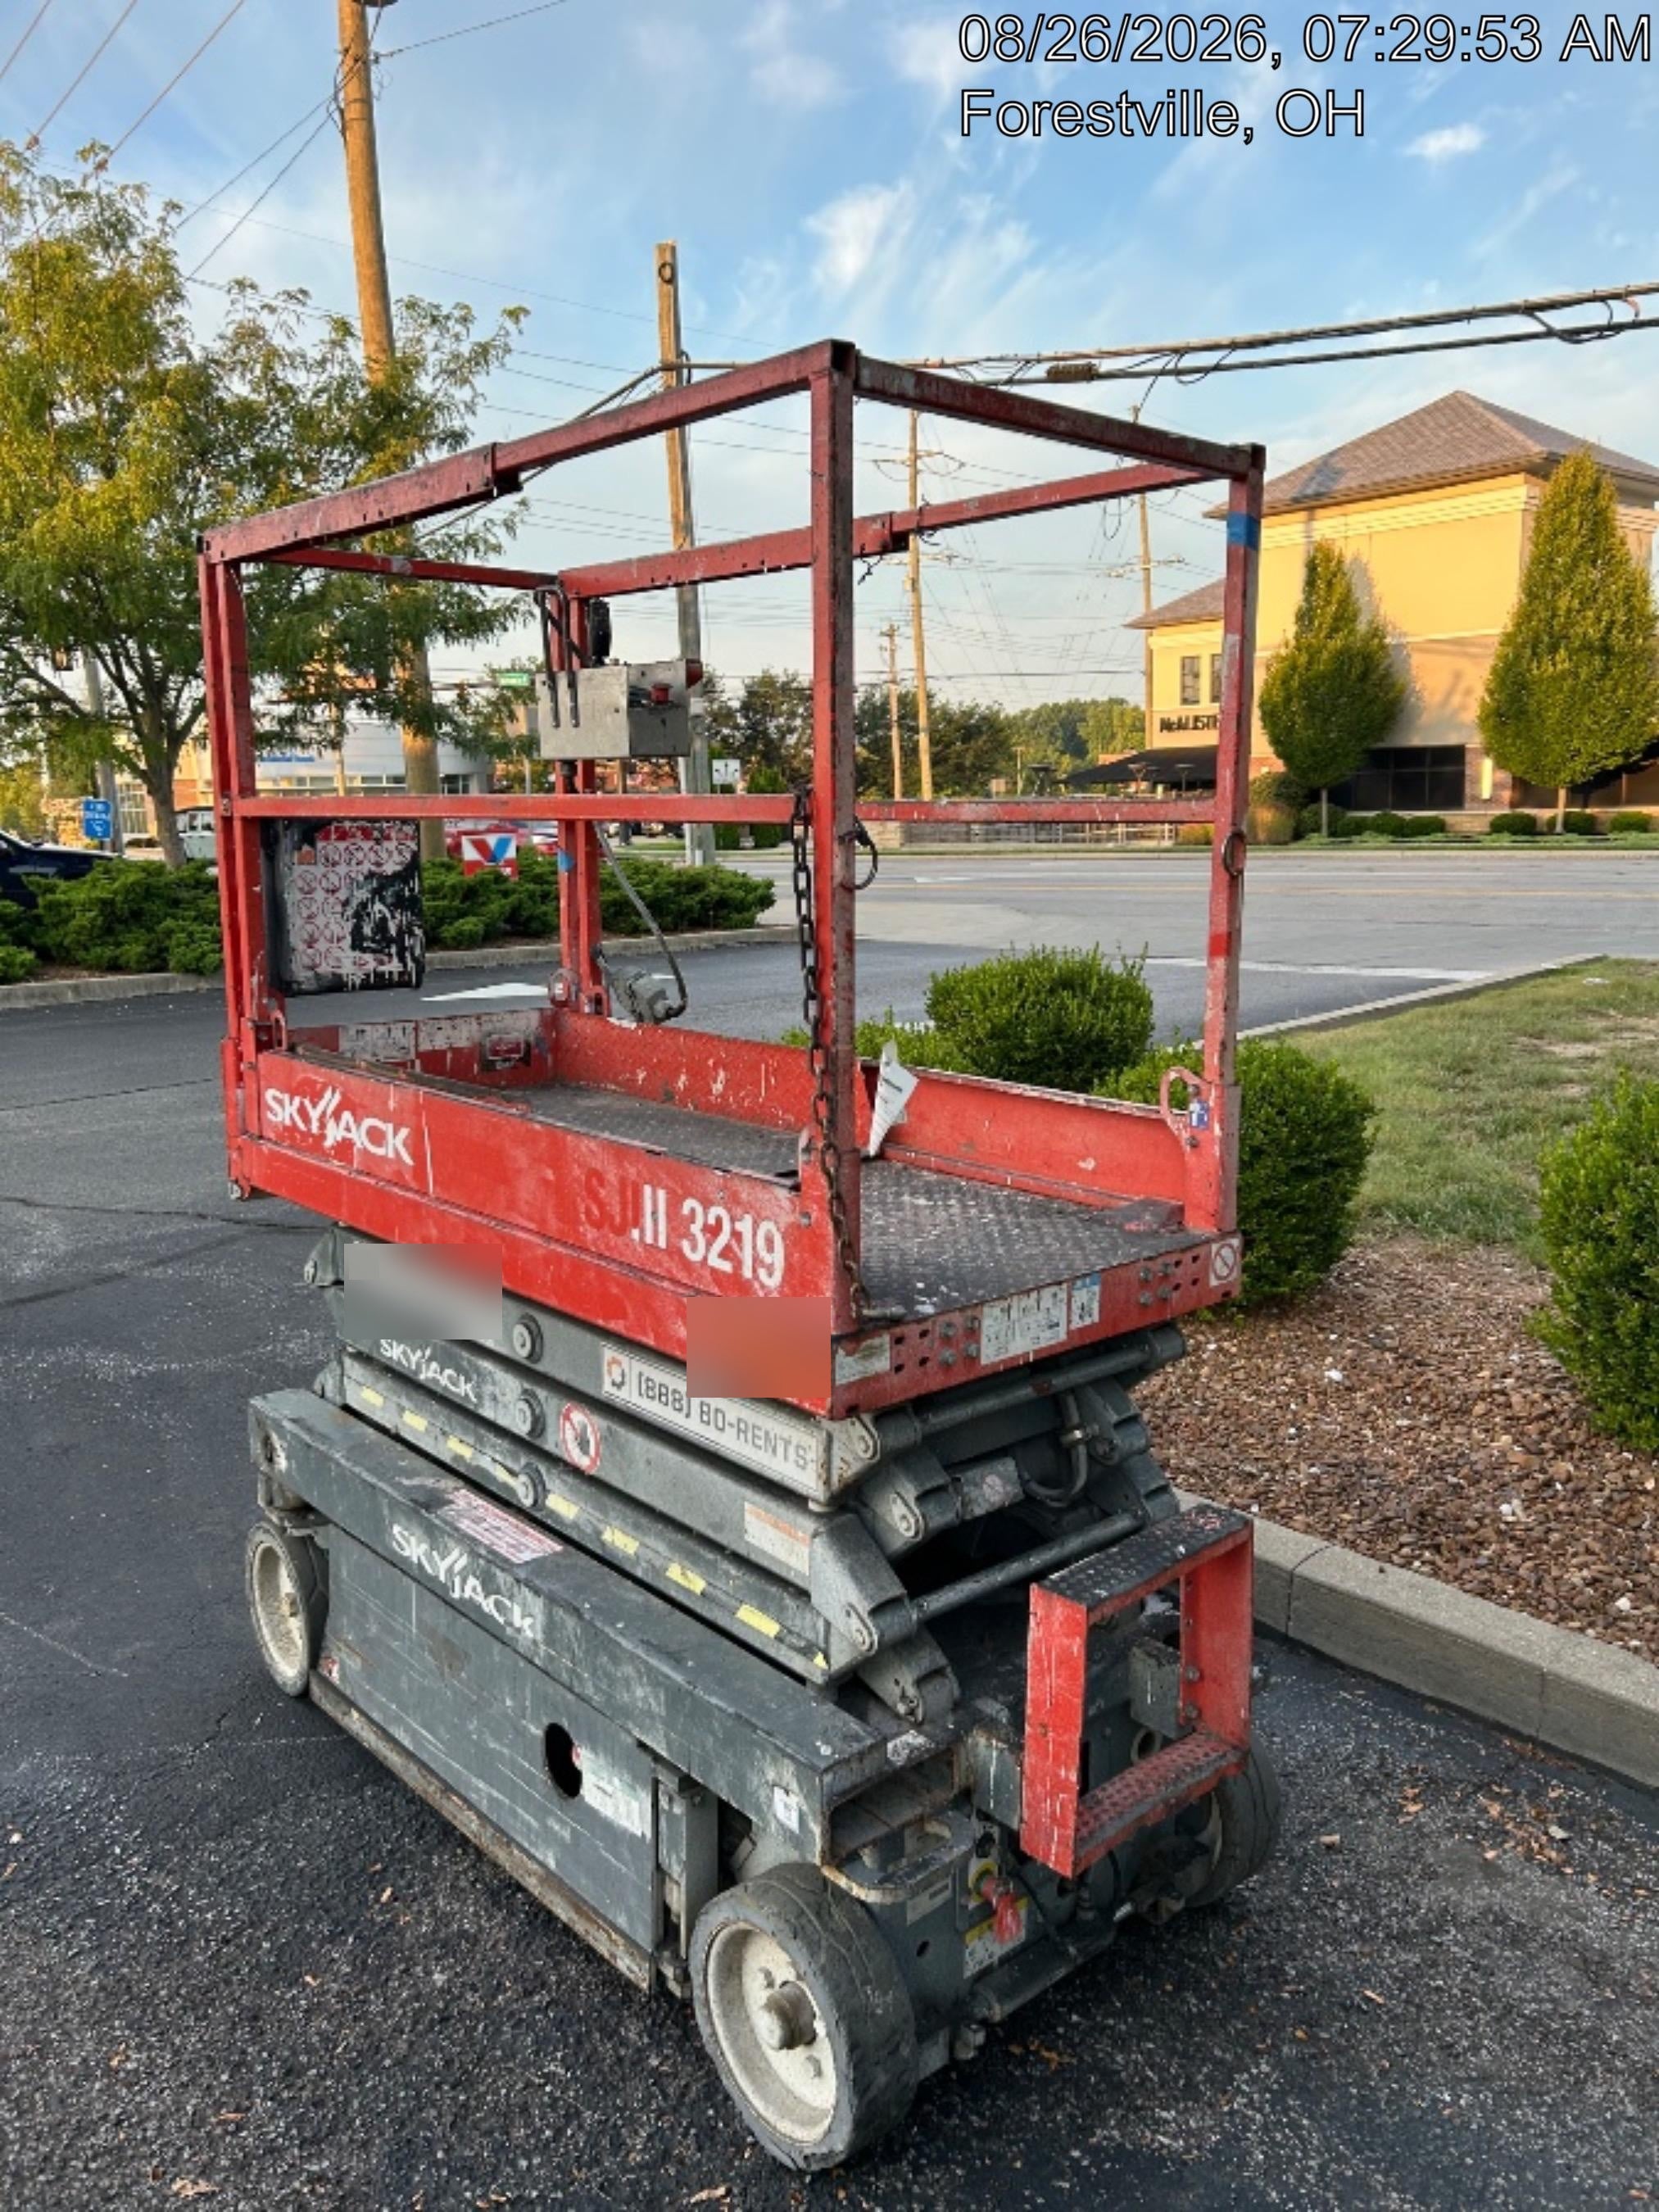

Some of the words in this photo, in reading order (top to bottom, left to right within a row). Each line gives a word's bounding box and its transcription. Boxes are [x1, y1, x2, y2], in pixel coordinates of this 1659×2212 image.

[265, 1086, 415, 1166] SKYJACK
[682, 1197, 785, 1289] 3219
[379, 1339, 477, 1403] SKYJACK
[392, 1523, 534, 1638] SKYJACK
